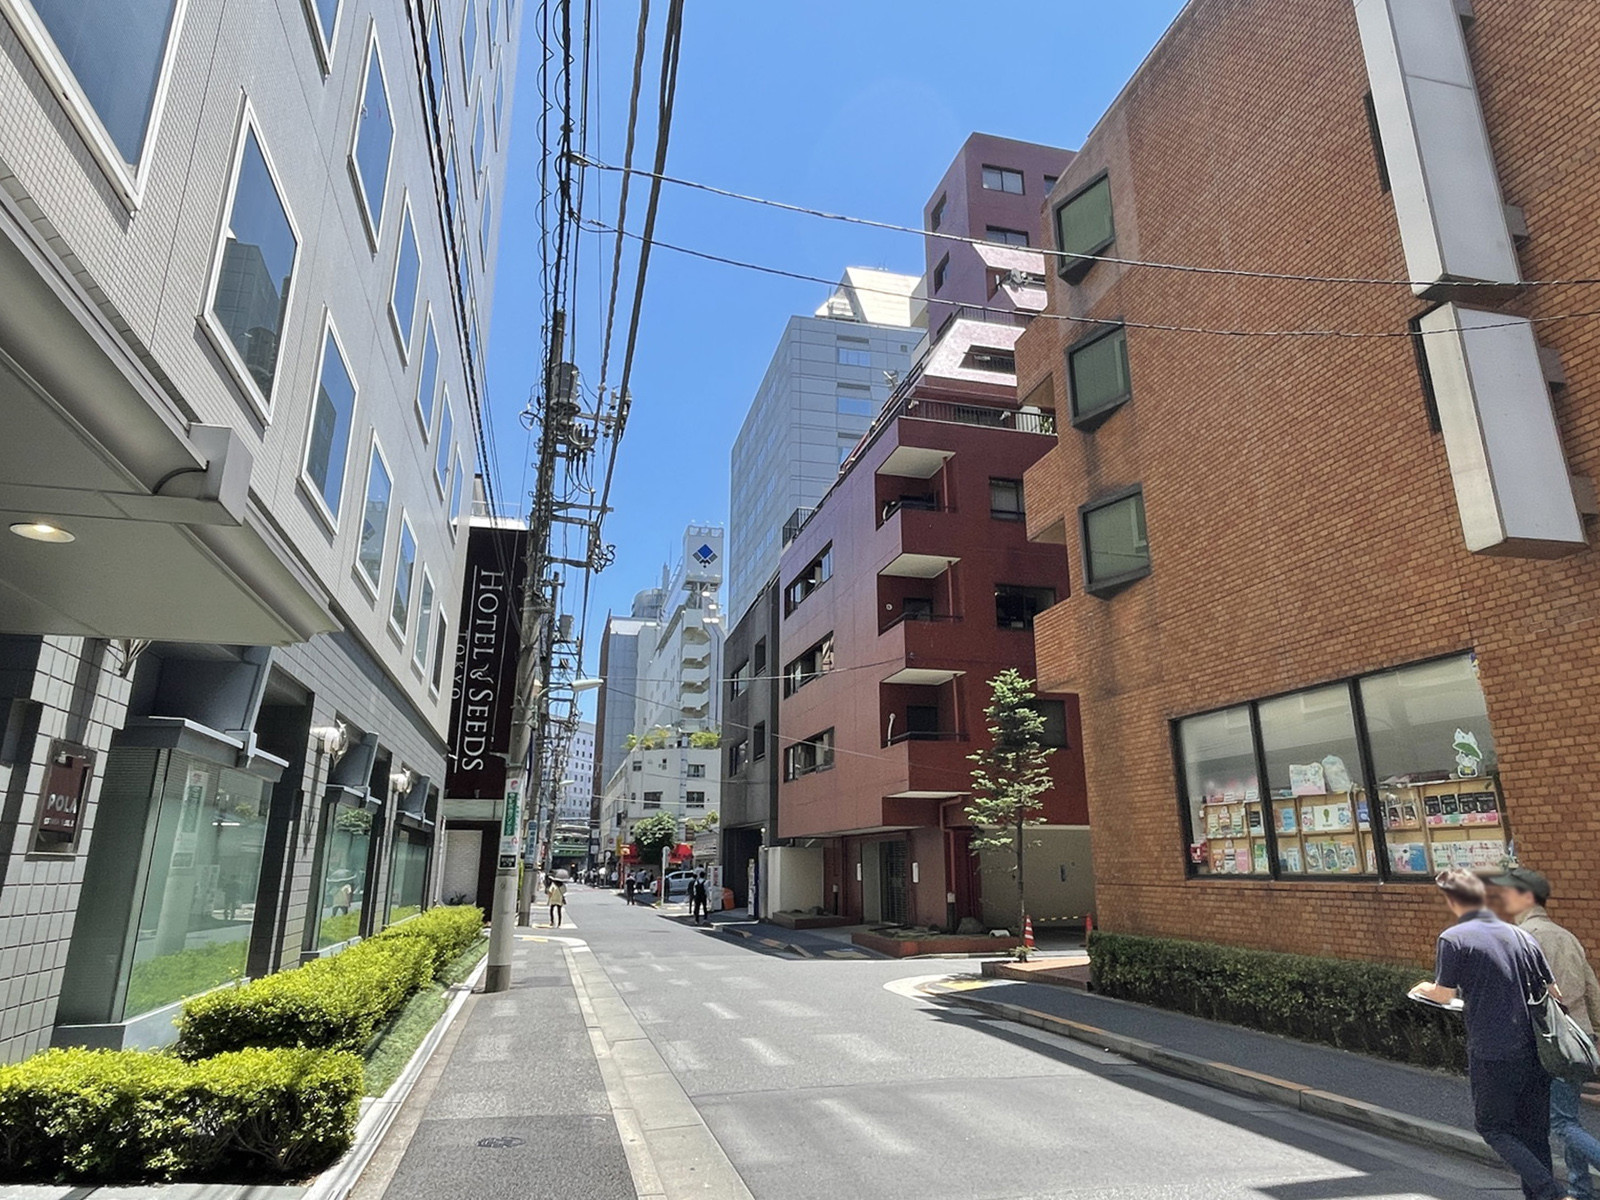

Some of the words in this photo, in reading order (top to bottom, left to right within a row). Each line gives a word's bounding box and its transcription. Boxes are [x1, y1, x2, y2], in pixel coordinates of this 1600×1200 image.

[472, 569, 504, 661] HOTEL
[462, 687, 493, 771] SEEDS
[47, 793, 77, 814] POLA
